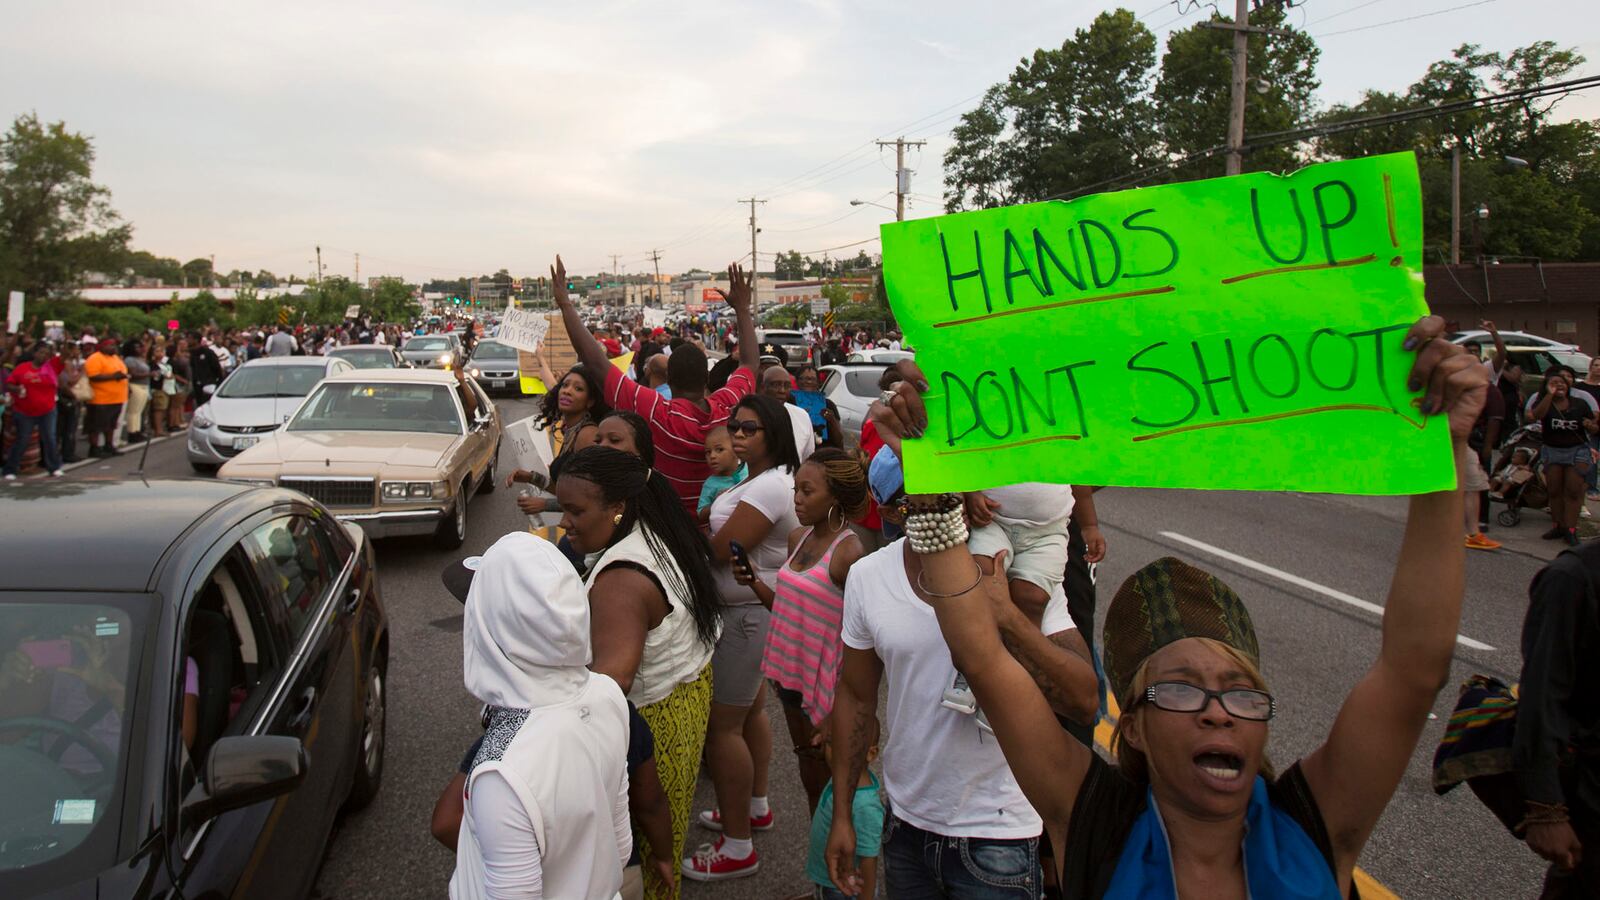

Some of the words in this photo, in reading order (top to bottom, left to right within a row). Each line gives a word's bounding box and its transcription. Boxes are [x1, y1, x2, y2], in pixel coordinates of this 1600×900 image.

[939, 208, 1179, 313] HANDS
[1250, 172, 1402, 266] UP!
[501, 324, 515, 341] NO
[504, 309, 522, 323] NO
[941, 360, 1095, 446] DONT
[1127, 323, 1414, 427] SHOOT
